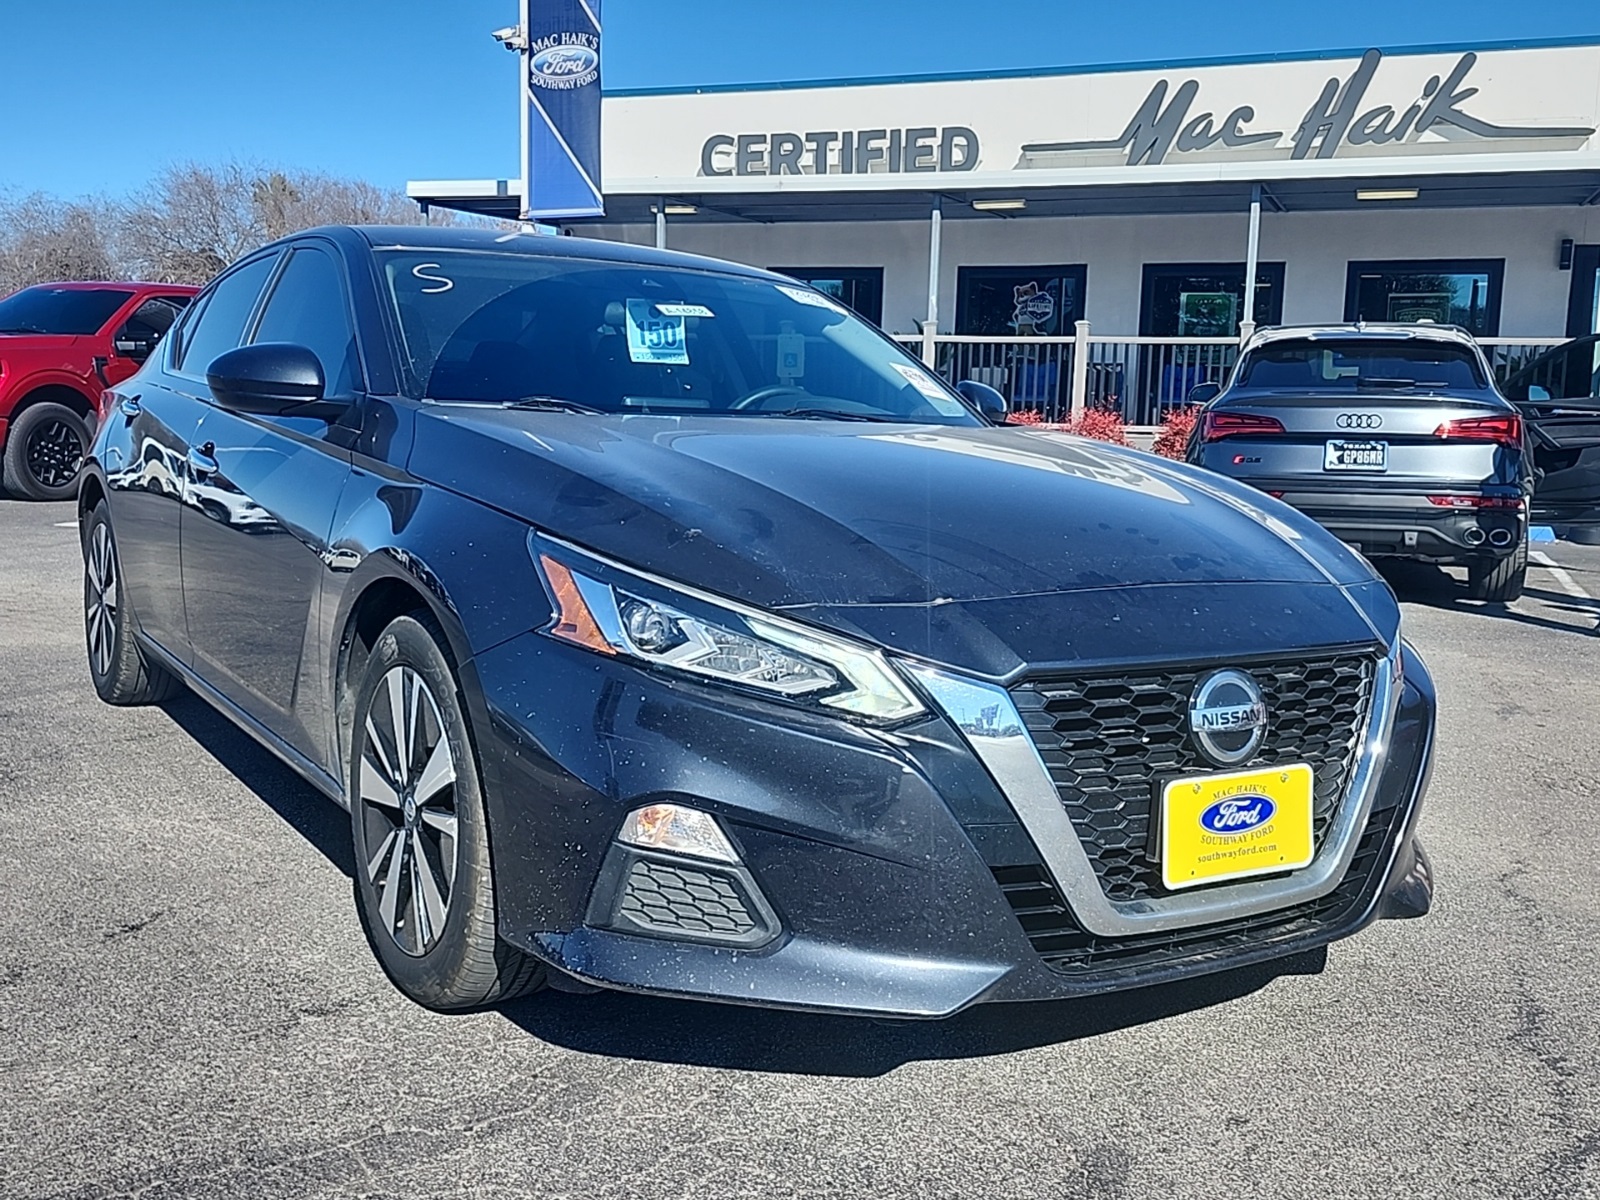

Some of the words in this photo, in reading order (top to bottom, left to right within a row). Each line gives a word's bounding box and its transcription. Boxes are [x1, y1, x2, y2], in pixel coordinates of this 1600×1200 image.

[531, 33, 558, 53] MAC
[561, 32, 599, 50] HAIK'S
[543, 50, 587, 75] Ford
[531, 74, 577, 90] SOUTHWAY
[576, 70, 598, 88] FORD
[1022, 78, 1281, 166] Mac
[1290, 48, 1597, 161] Haik
[699, 125, 980, 176] CERTIFIED
[412, 263, 454, 294] S
[636, 320, 677, 347] 150
[1201, 709, 1262, 727] NISSAN
[1212, 787, 1233, 801] MAC
[1235, 784, 1268, 795] HAIK'S
[1213, 799, 1262, 829] Ford
[1200, 833, 1249, 846] SOUTHWAY
[1250, 824, 1275, 841] FORD
[1197, 844, 1278, 864] southwayford.com
